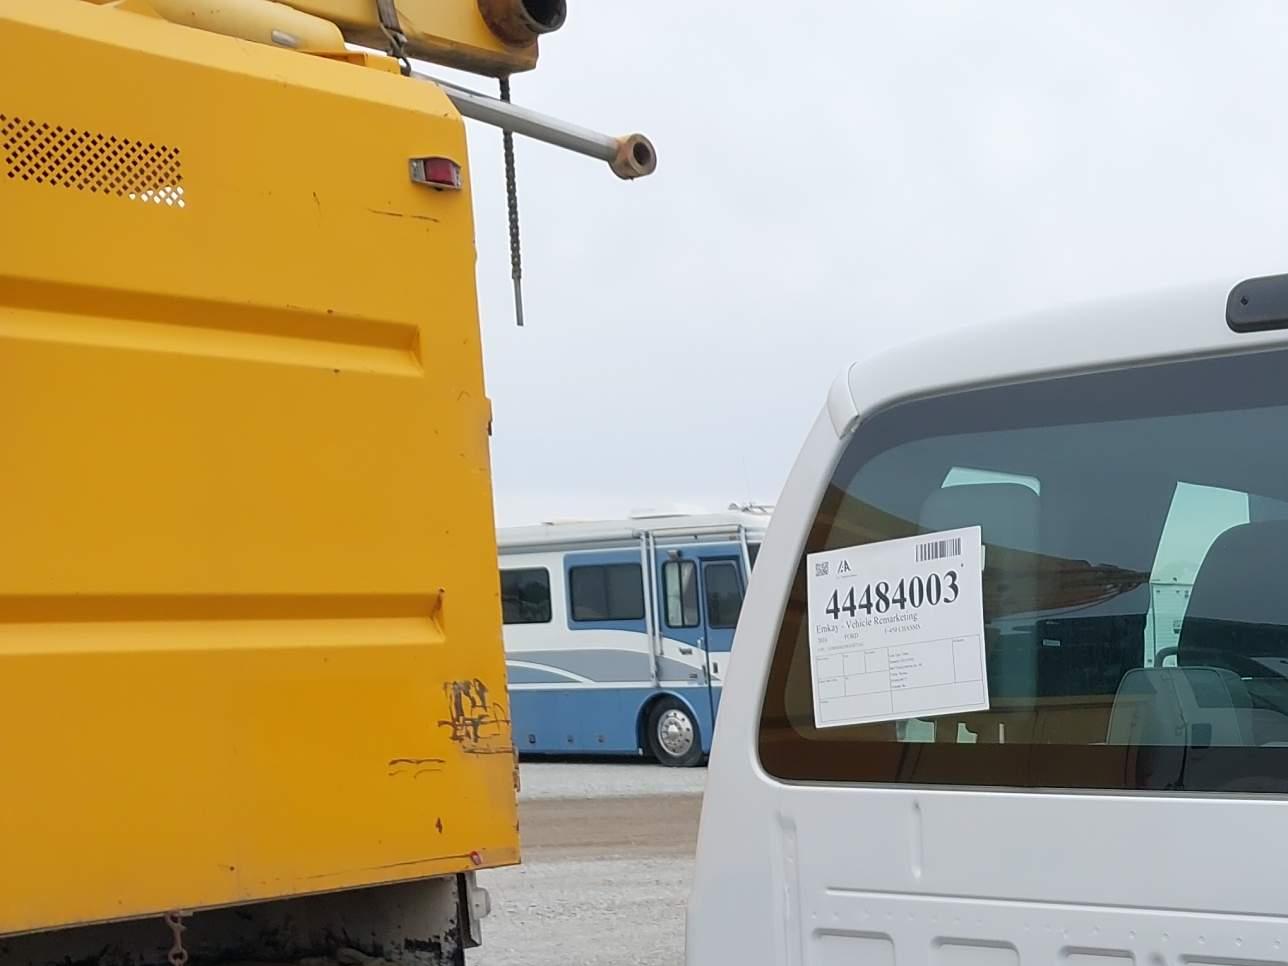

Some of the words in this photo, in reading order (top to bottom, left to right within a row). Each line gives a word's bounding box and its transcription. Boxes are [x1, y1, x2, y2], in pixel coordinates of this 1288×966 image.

[825, 570, 960, 620] 44484003
[816, 623, 840, 635] Emkay
[845, 616, 872, 630] Vehicle
[873, 612, 918, 626] Remarketing
